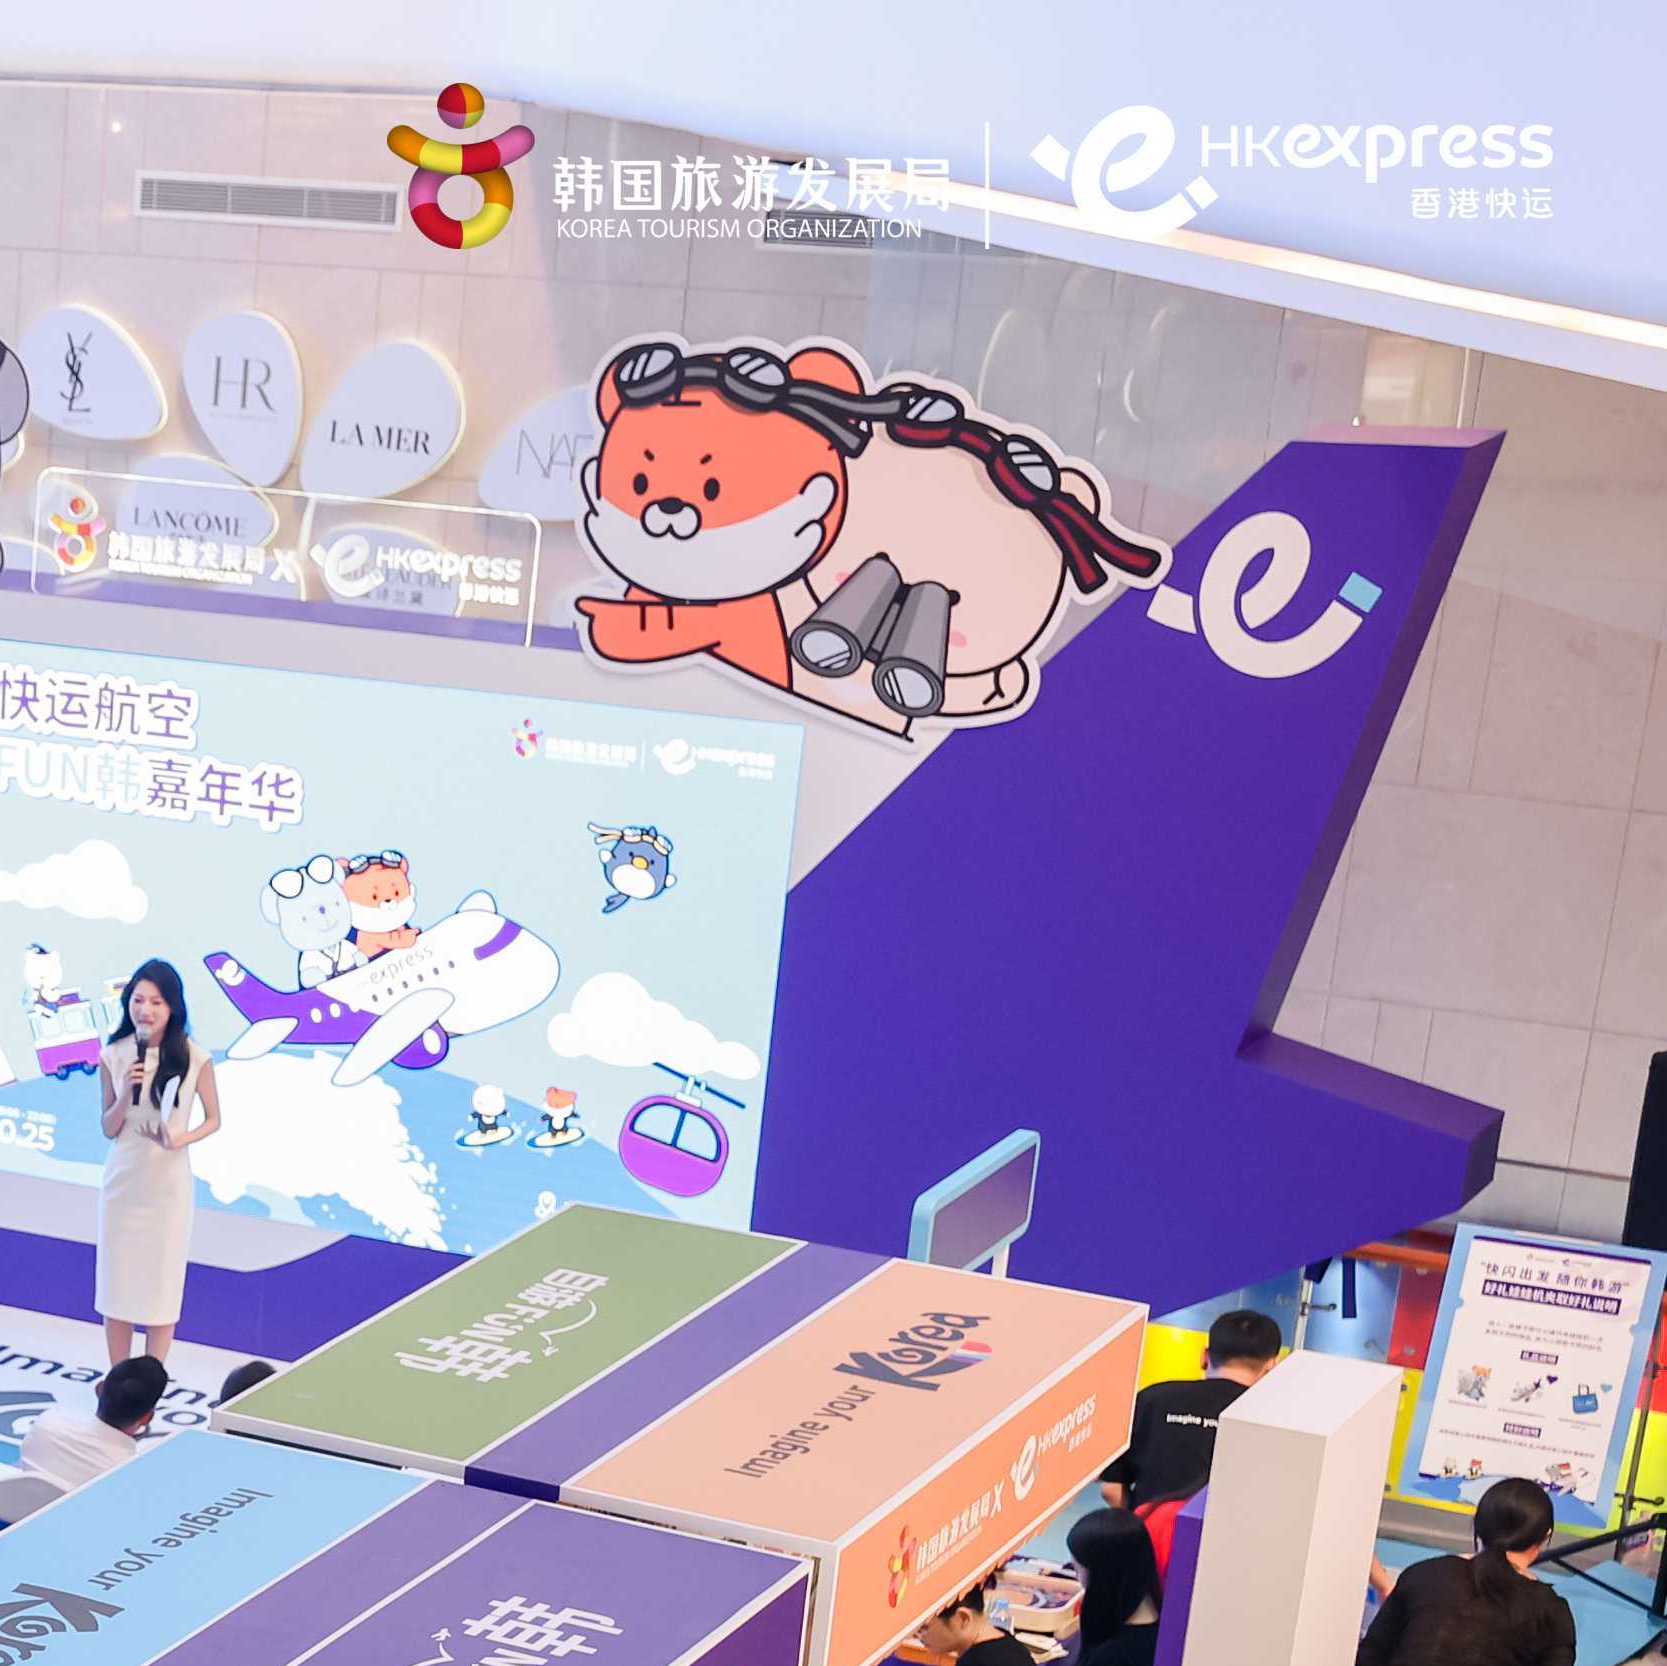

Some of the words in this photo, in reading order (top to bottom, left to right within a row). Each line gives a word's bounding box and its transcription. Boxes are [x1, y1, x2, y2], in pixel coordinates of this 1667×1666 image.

[212, 355, 276, 412] HR
[330, 418, 369, 448] LA
[373, 425, 431, 457] MER
[833, 1311, 993, 1392] Korea
[814, 1384, 877, 1423] your
[724, 1418, 829, 1479] Imagine
[151, 1488, 275, 1549] Imagine
[88, 1548, 164, 1591] your
